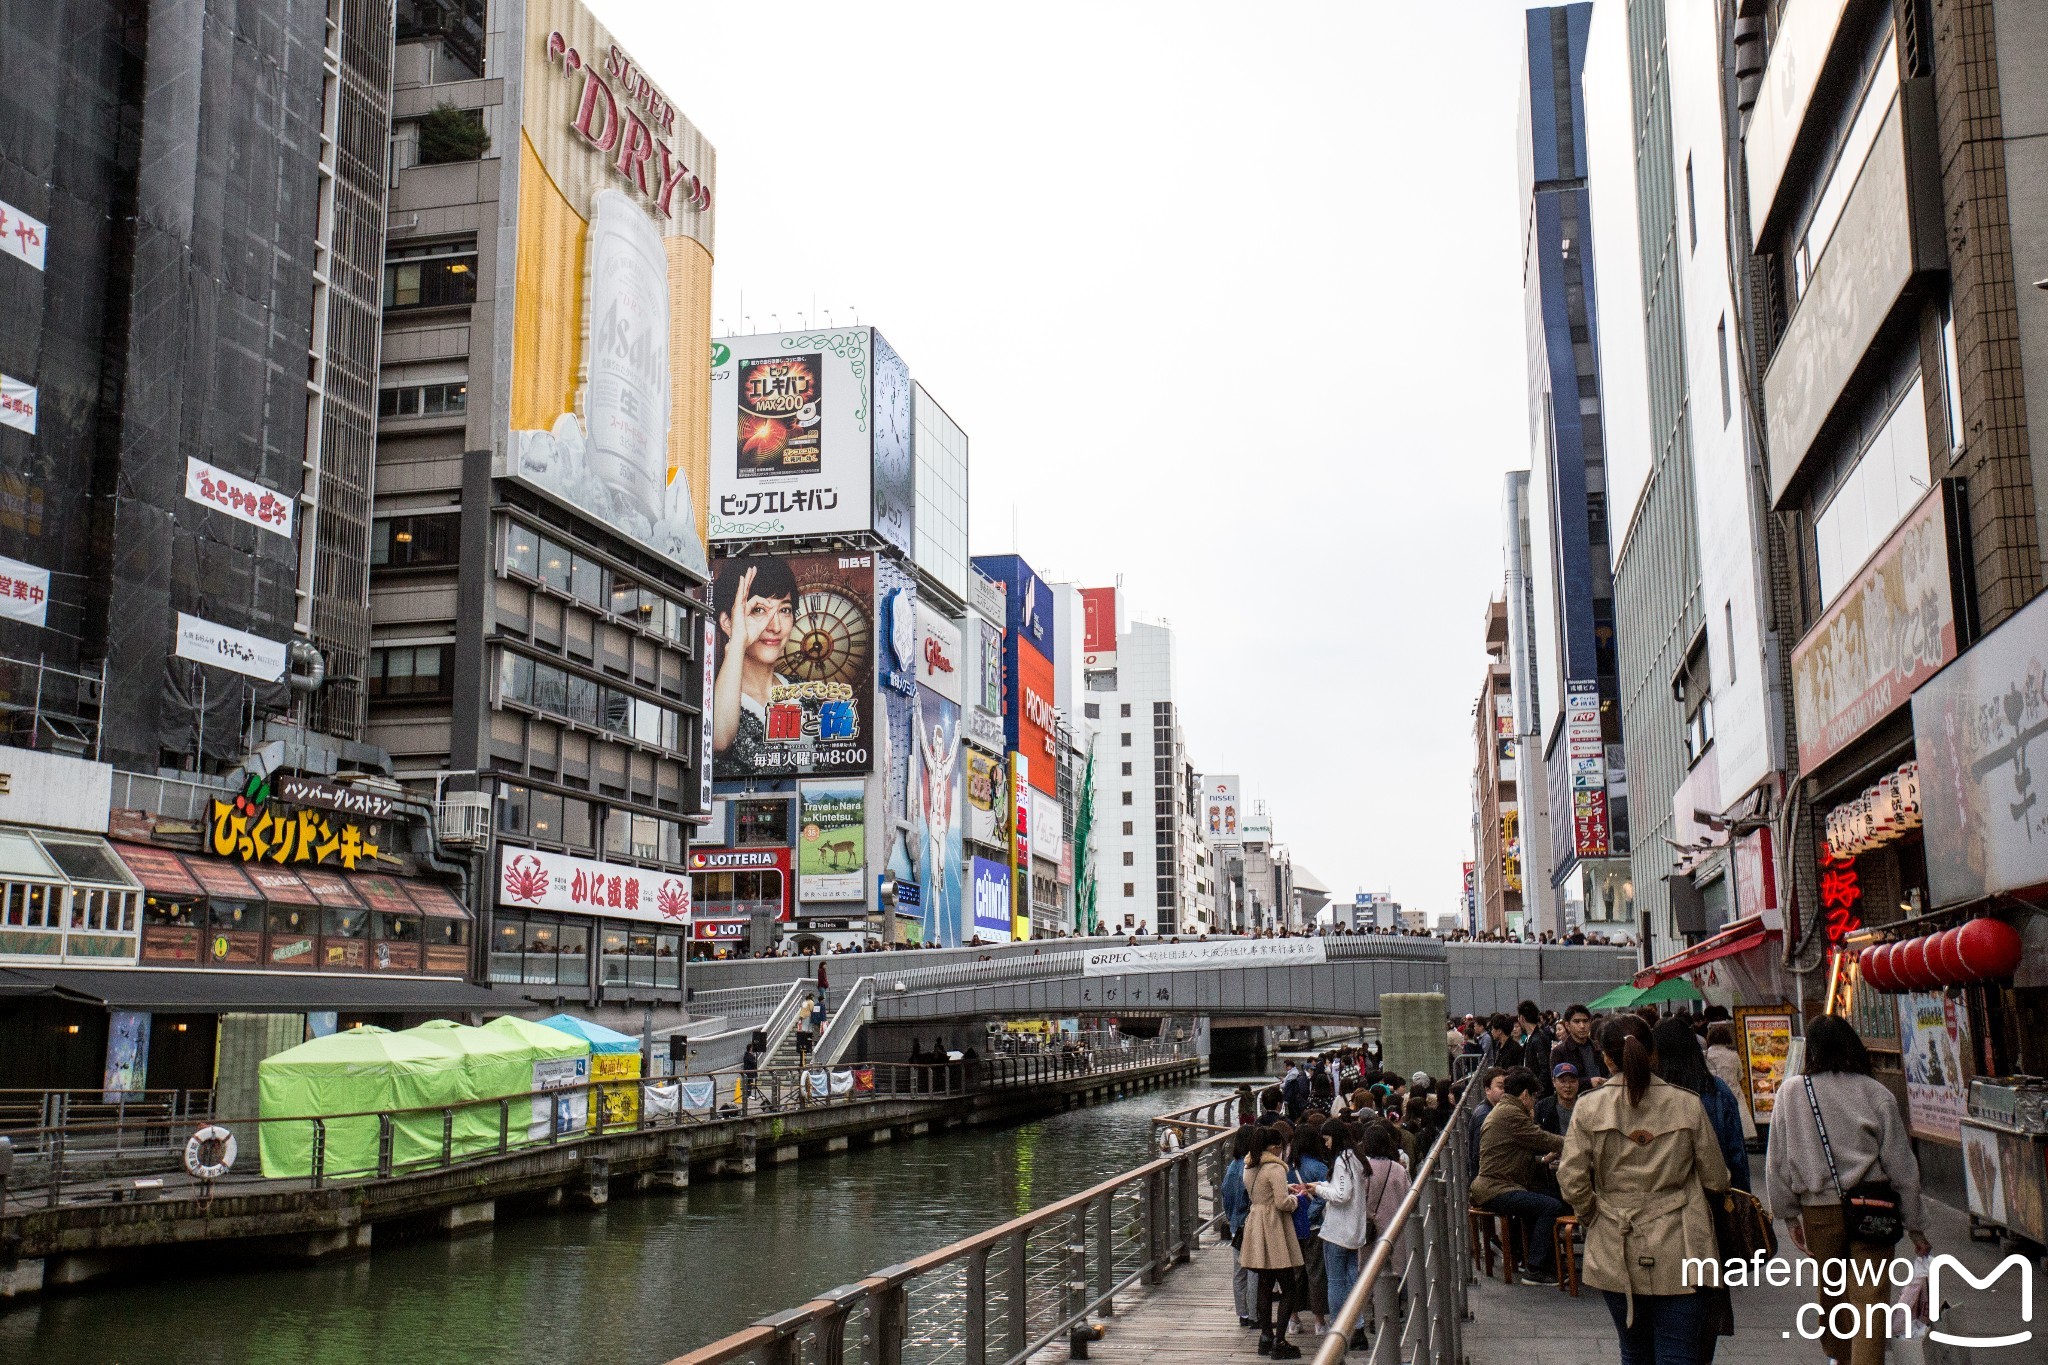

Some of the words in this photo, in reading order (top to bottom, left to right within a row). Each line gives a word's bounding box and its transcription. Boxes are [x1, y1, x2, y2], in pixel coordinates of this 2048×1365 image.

[604, 45, 675, 136] SUPER
[749, 376, 811, 398] エレキバン
[720, 487, 838, 516] ピップエレキバン
[838, 556, 871, 569] MBS
[771, 680, 853, 702] 教えてもらう
[754, 751, 811, 767] 毎週火曜
[285, 783, 392, 815] ハンバーグレストラン
[803, 802, 831, 811] Travel
[839, 801, 861, 811] Nara
[812, 813, 854, 822] Kintetsu.
[1592, 790, 1605, 848] インターネット
[214, 799, 379, 872] びっくりドンキー
[1578, 816, 1590, 849] コミック
[709, 853, 773, 866] LOTTERIA
[1140, 949, 1198, 962] 一般社団法人
[1083, 988, 1170, 1001] えびす橋
